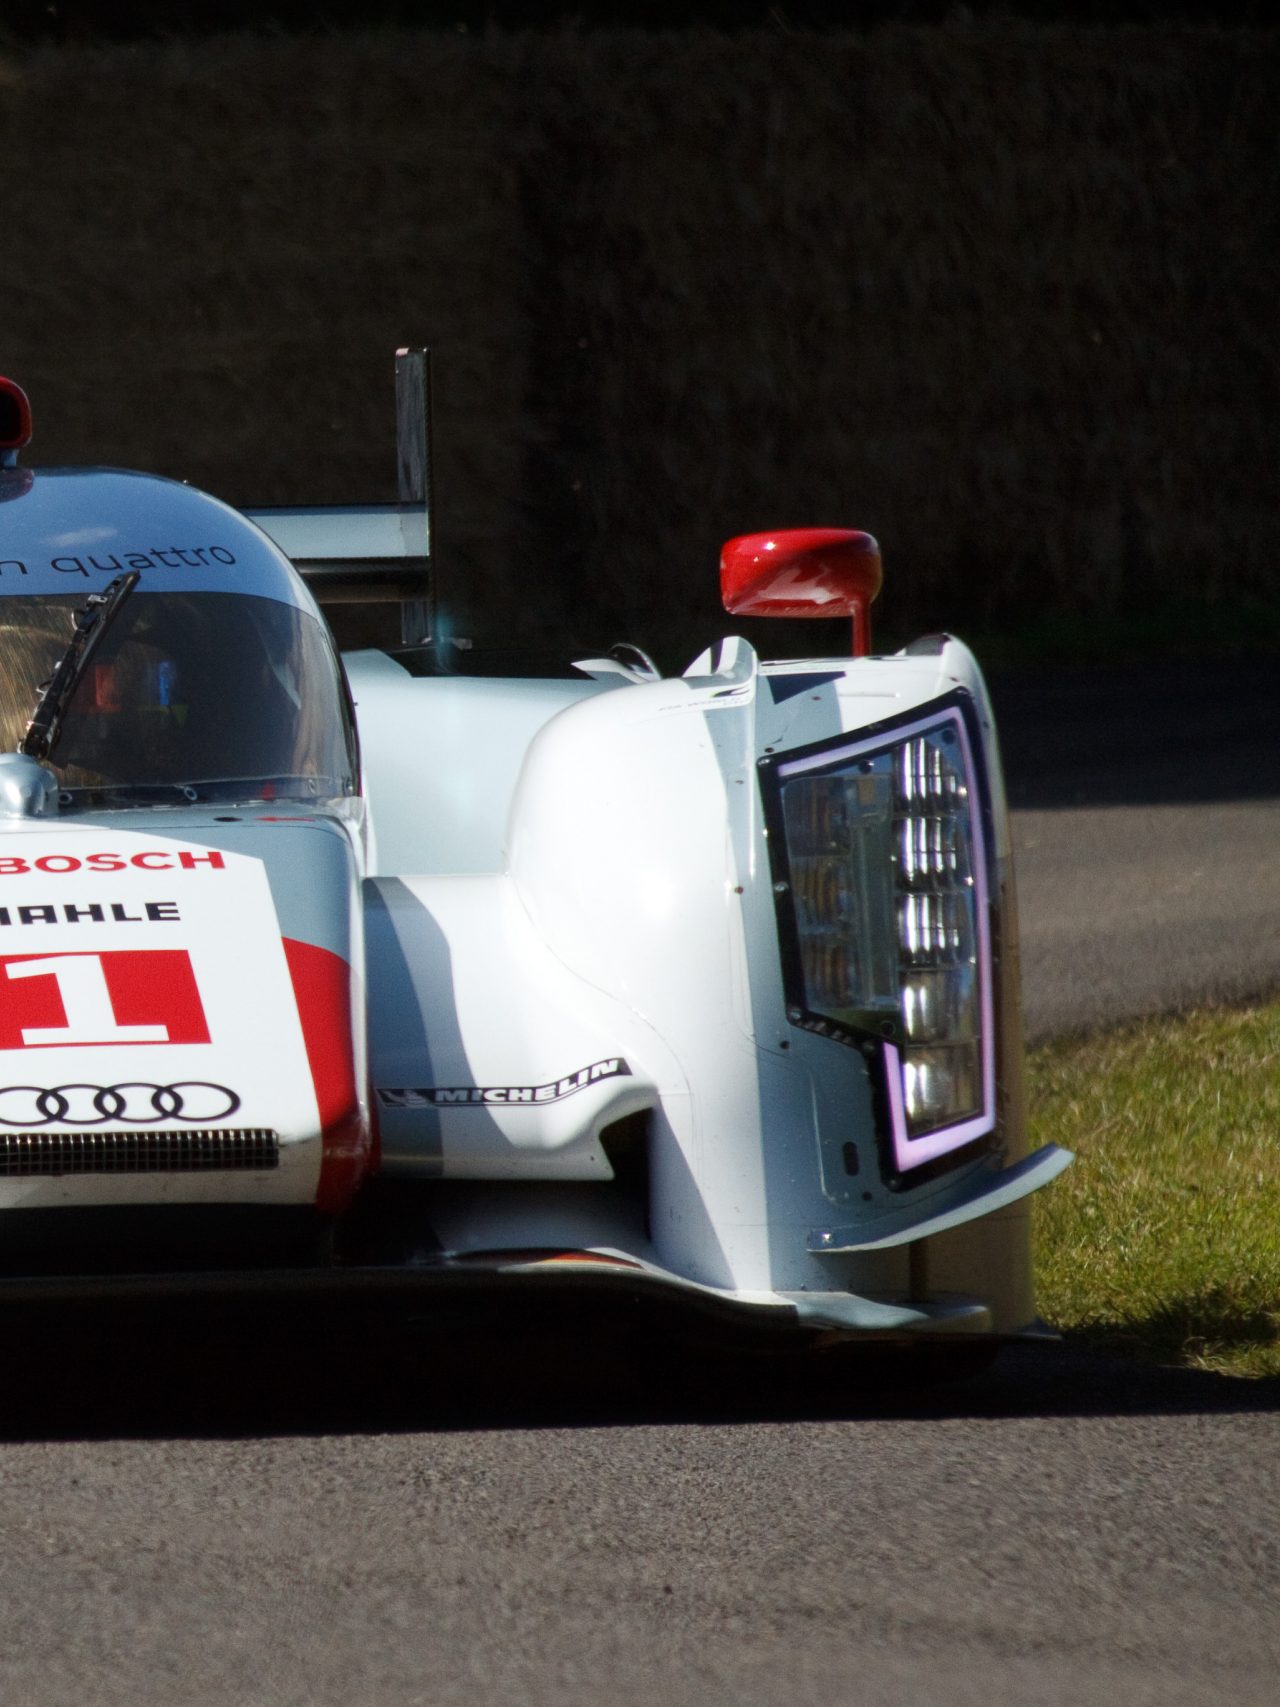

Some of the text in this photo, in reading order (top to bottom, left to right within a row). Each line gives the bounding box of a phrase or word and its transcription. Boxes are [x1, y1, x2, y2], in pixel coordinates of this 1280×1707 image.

[51, 543, 237, 579] quattro
[5, 955, 170, 1045] 1
[435, 1058, 620, 1103] MICHELIN
